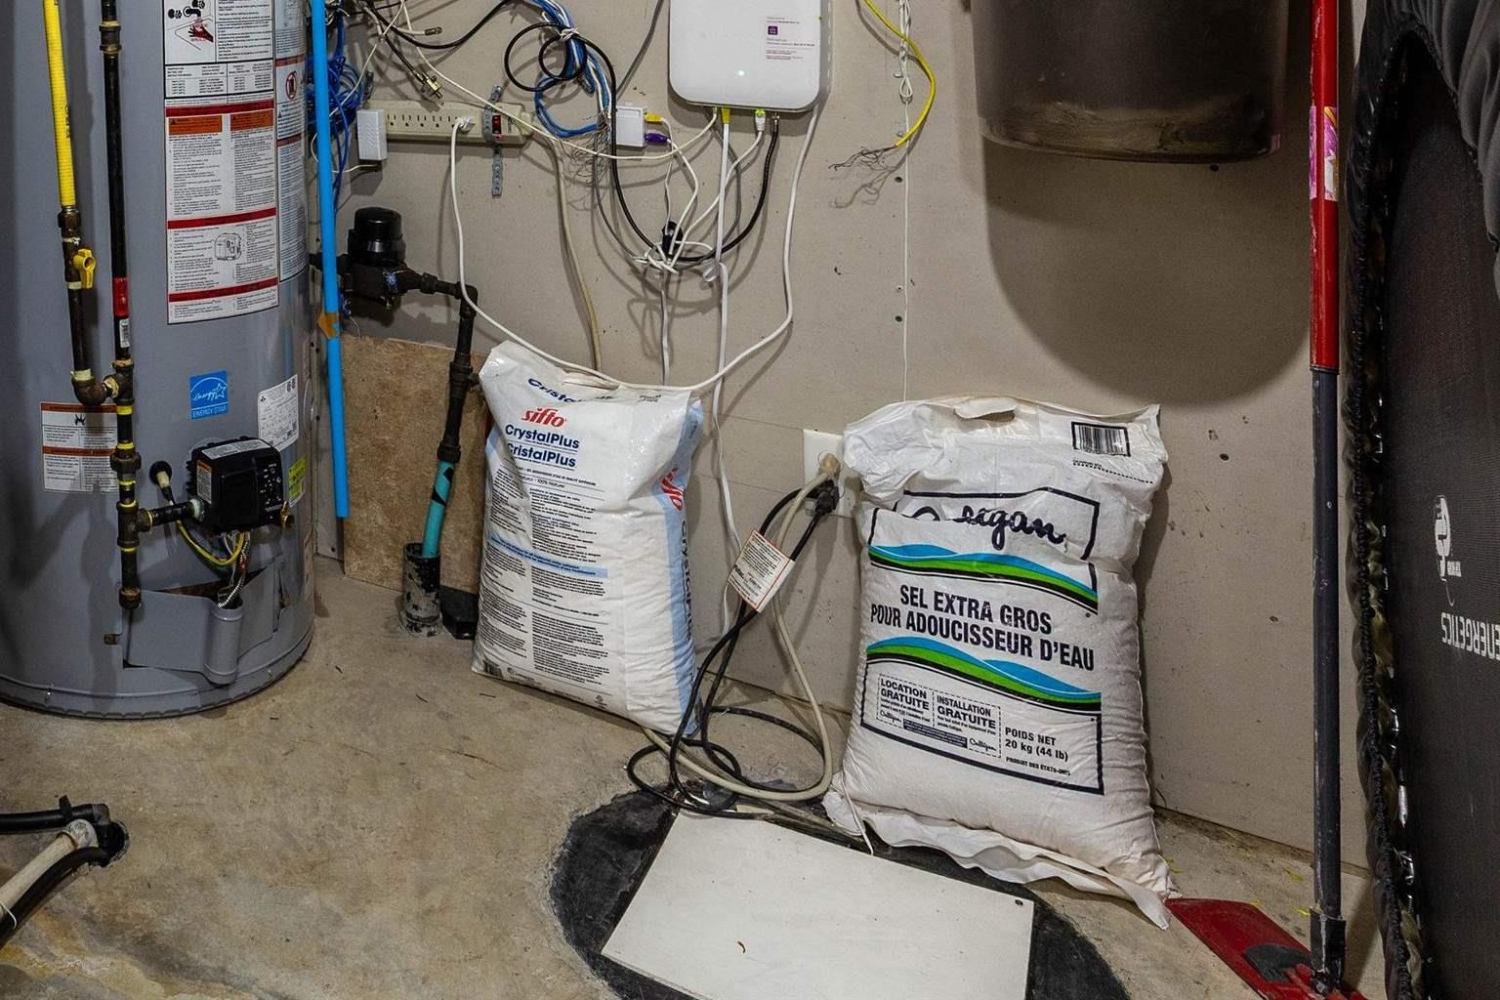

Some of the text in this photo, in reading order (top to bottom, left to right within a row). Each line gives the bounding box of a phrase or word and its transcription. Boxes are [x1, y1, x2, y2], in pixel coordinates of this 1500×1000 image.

[505, 424, 580, 449] CrystalPlus
[507, 443, 576, 467] CristalPlus
[900, 584, 1051, 635] SEL EXTRA GROS
[870, 603, 1094, 672] POUR ADOUCISSEUR D'EAU
[880, 678, 927, 700] LOCATION
[880, 688, 929, 711] GRATUITE
[936, 695, 991, 717] INSTALLATION
[937, 705, 996, 729] GRATUITE
[1005, 727, 1057, 746] POIDS NET
[1005, 739, 1069, 762] 20 kg (44 lb)
